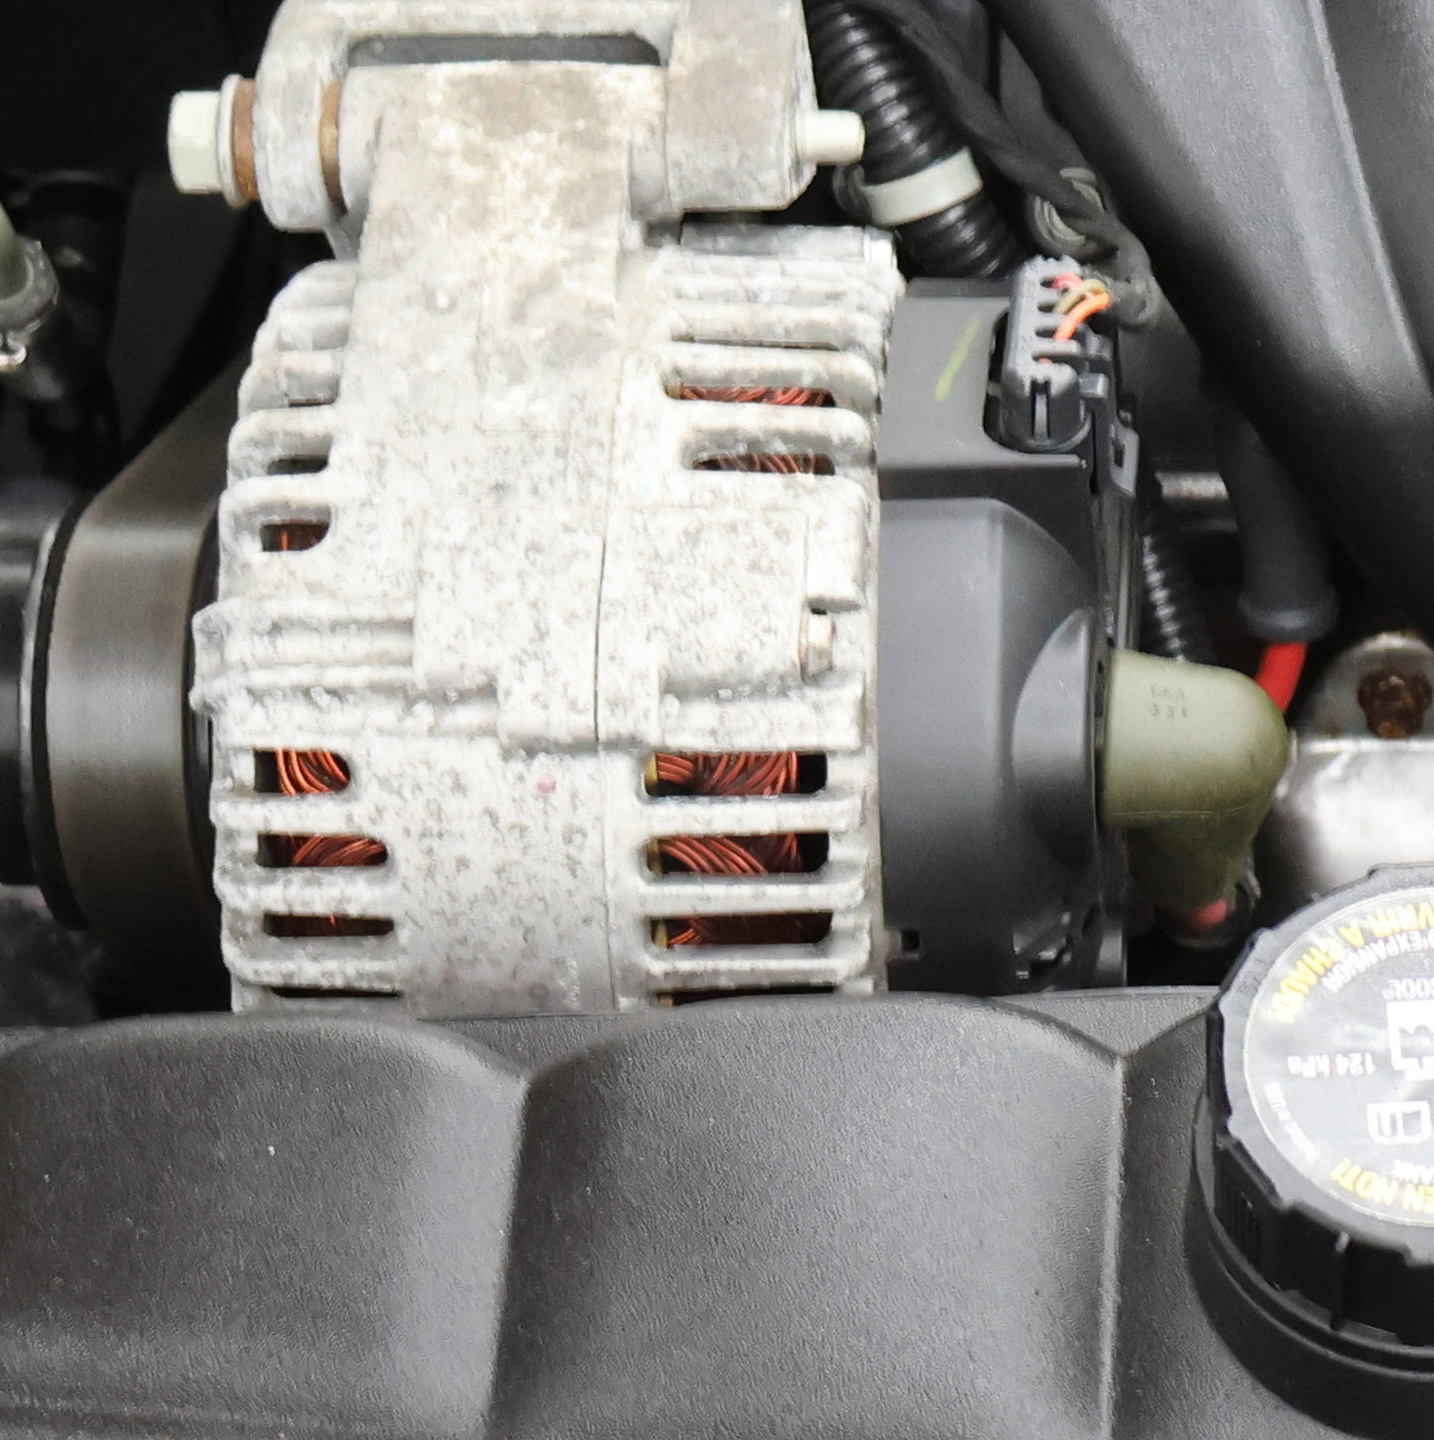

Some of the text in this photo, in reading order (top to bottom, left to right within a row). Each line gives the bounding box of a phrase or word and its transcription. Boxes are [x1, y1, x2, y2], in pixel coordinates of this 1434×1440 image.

[1286, 1051, 1378, 1079] 124 kPa
[1329, 1156, 1400, 1207] HOT!
